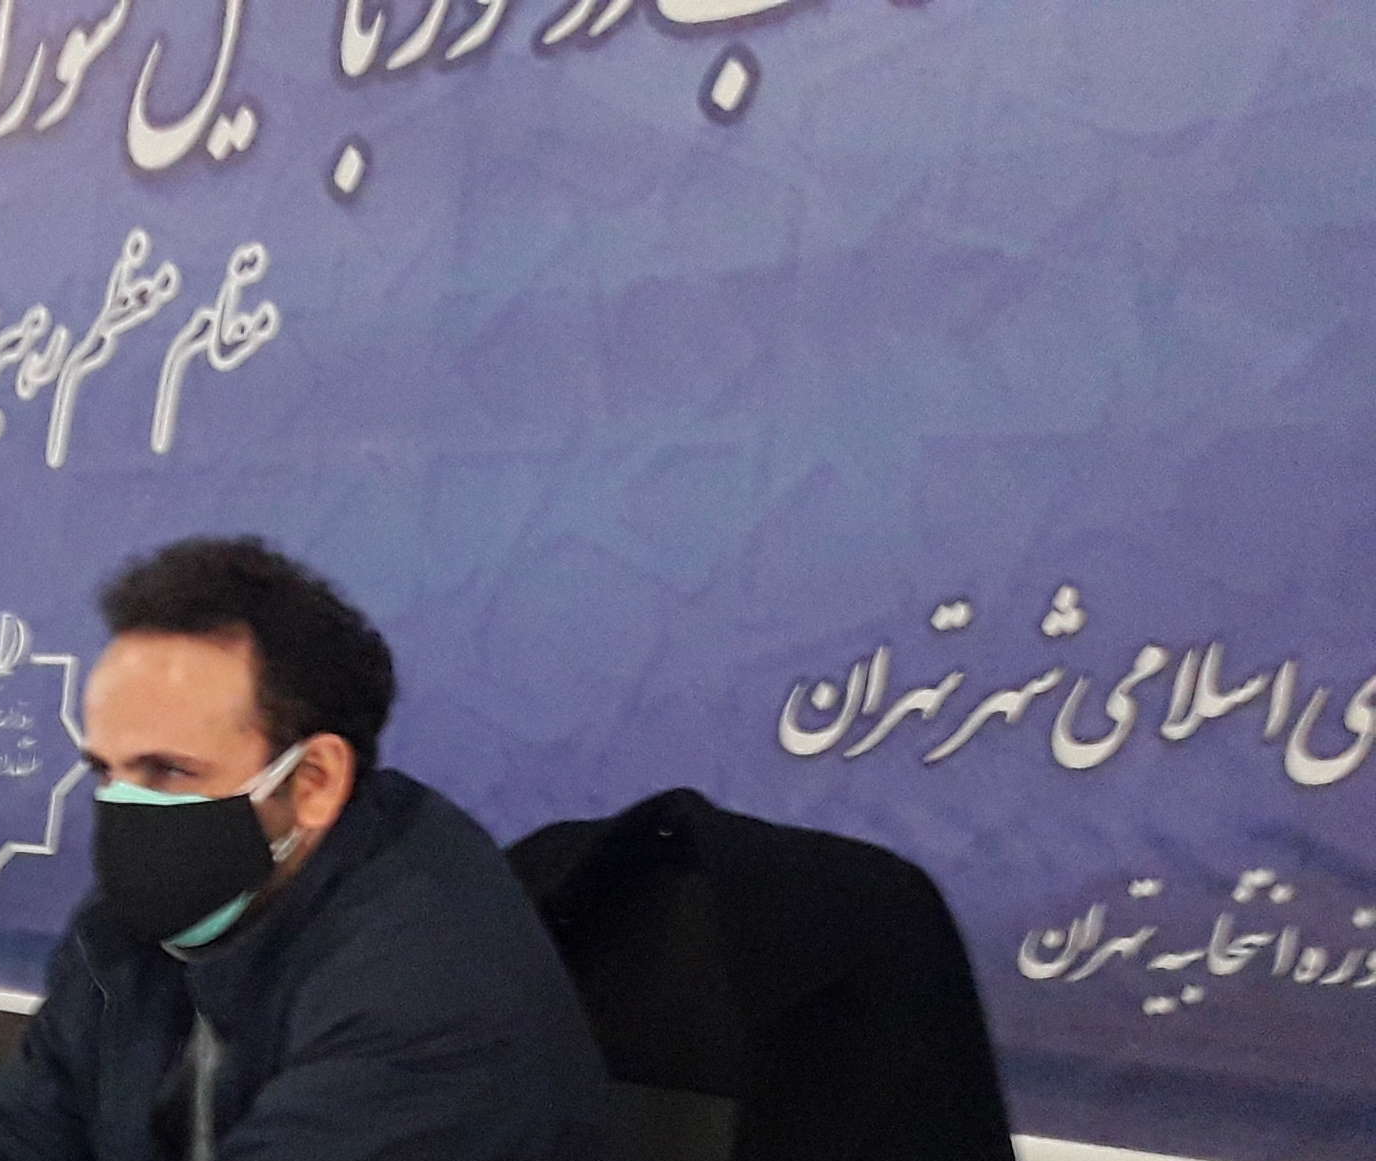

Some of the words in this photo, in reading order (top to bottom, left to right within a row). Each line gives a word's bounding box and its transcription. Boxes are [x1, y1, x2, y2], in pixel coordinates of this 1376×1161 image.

[46, 226, 182, 469] معظم
[151, 240, 280, 454] مقام
[777, 598, 975, 757] تهران
[922, 583, 1089, 766] شهر
[1050, 641, 1300, 770] اسلامی
[1017, 877, 1165, 982] تهران
[1140, 867, 1300, 1017] انتخابیه
